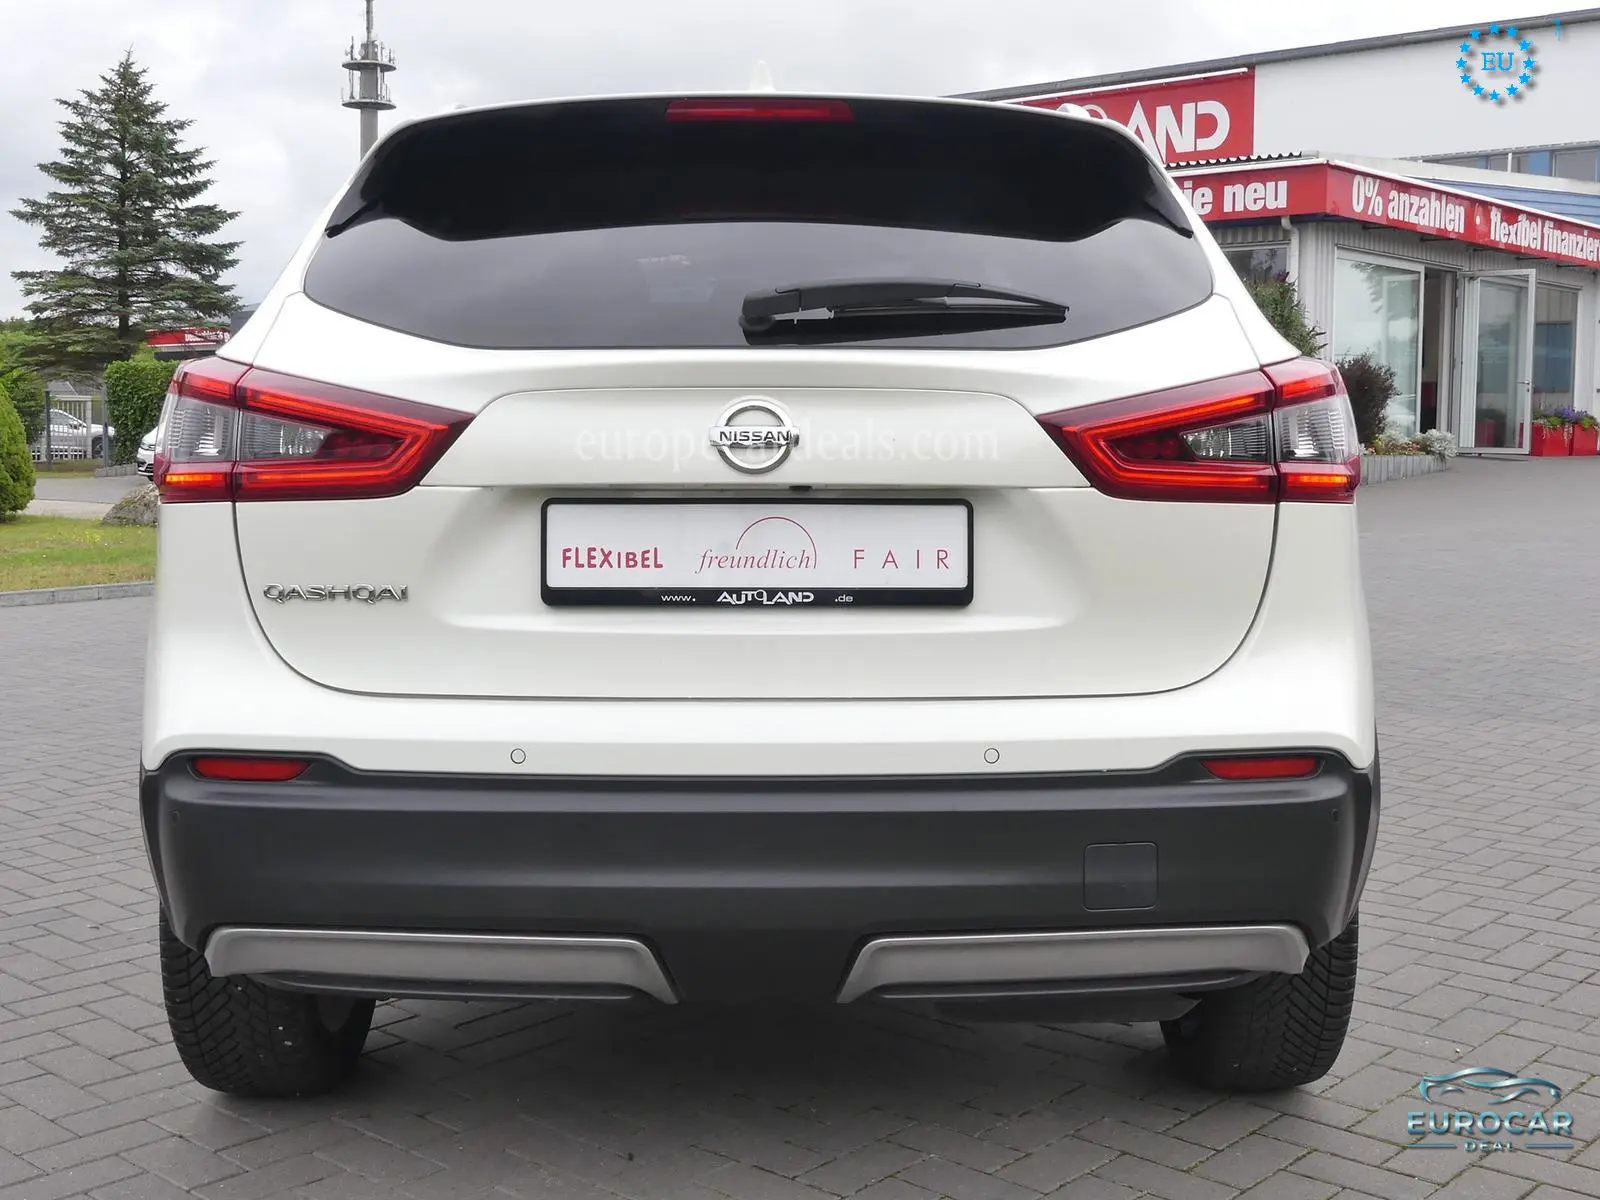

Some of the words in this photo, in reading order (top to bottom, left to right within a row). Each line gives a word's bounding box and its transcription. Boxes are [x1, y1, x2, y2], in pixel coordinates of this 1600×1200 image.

[1223, 180, 1288, 213] neu
[1352, 174, 1383, 217] 0%
[1387, 189, 1465, 234] anzahlen
[1490, 206, 1542, 250] flexibel
[719, 430, 790, 442] NISSAN
[562, 546, 664, 569] FLEXIBEL
[694, 549, 811, 574] freundlich
[263, 583, 409, 604] QASHQAI
[716, 589, 814, 605] AUTOLAND
